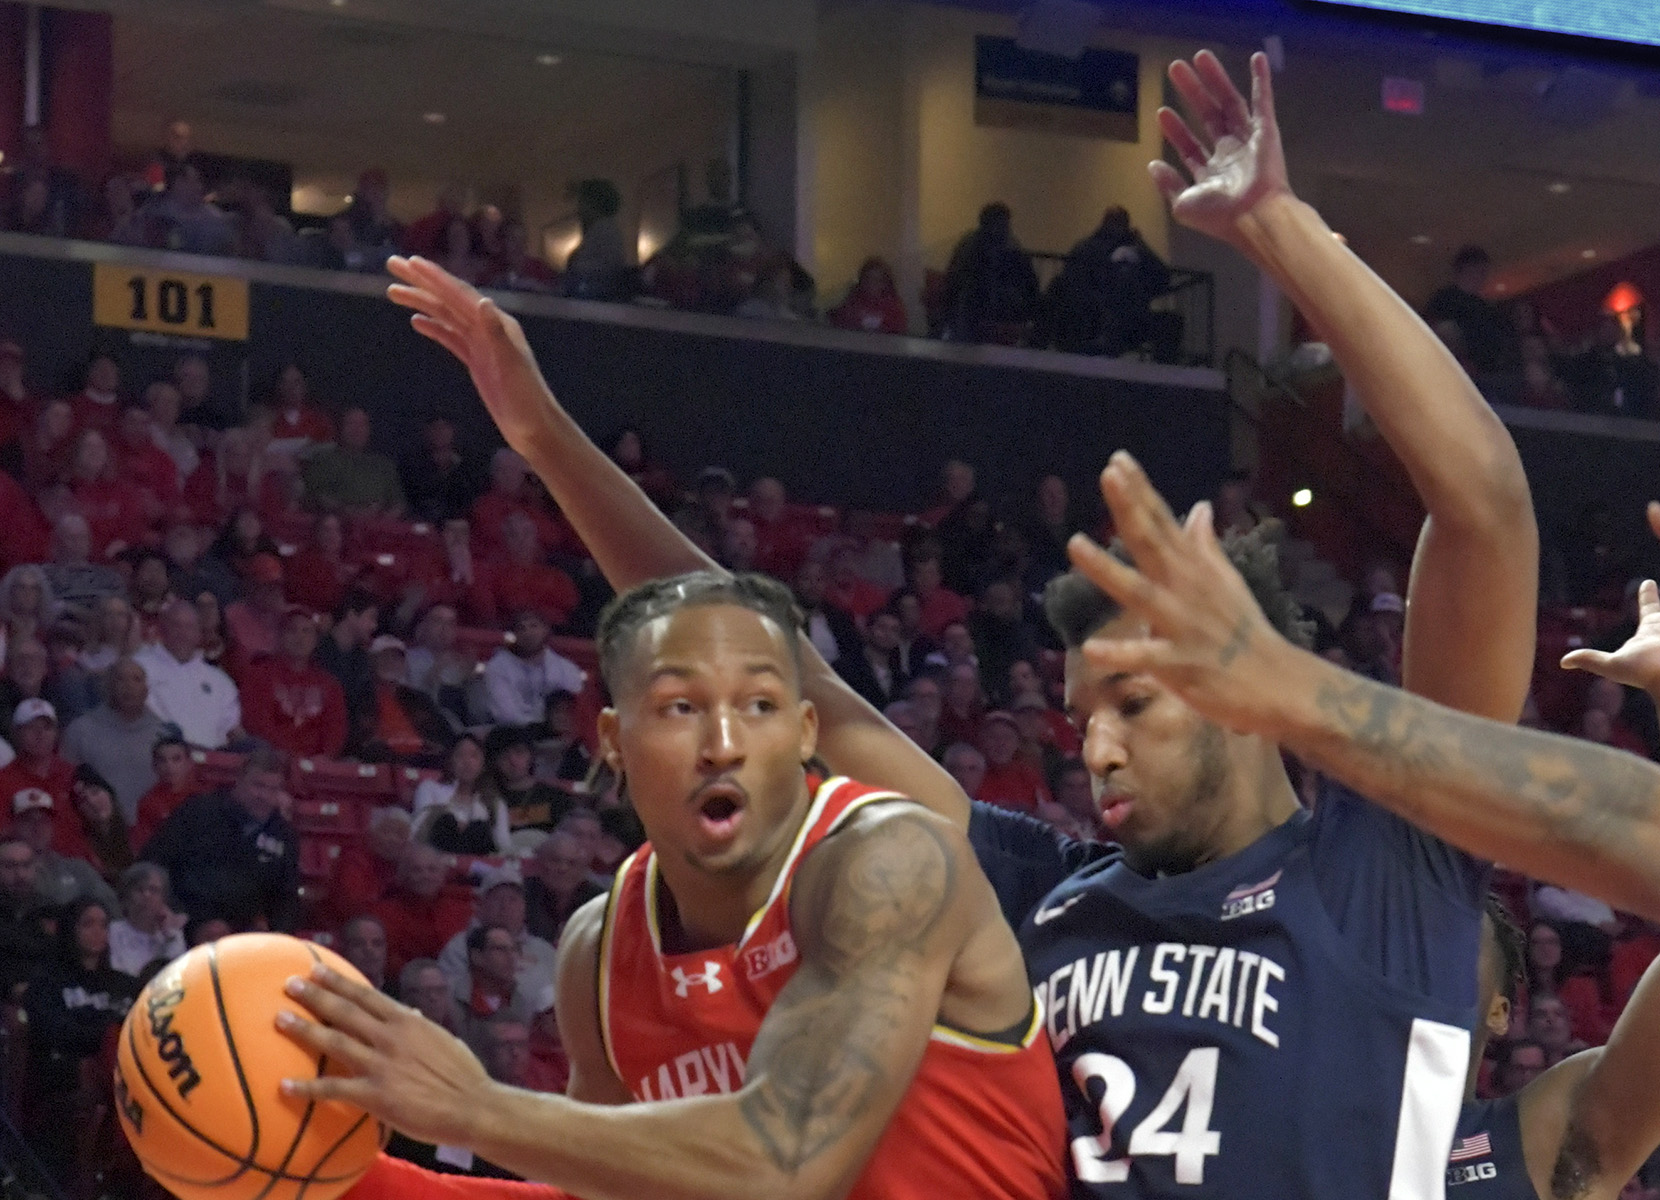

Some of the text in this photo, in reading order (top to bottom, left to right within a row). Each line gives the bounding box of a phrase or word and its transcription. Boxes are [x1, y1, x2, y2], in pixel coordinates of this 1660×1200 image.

[128, 276, 216, 328] 101
[1034, 943, 1286, 1052] ENN STATE
[1071, 1047, 1221, 1185] 24
